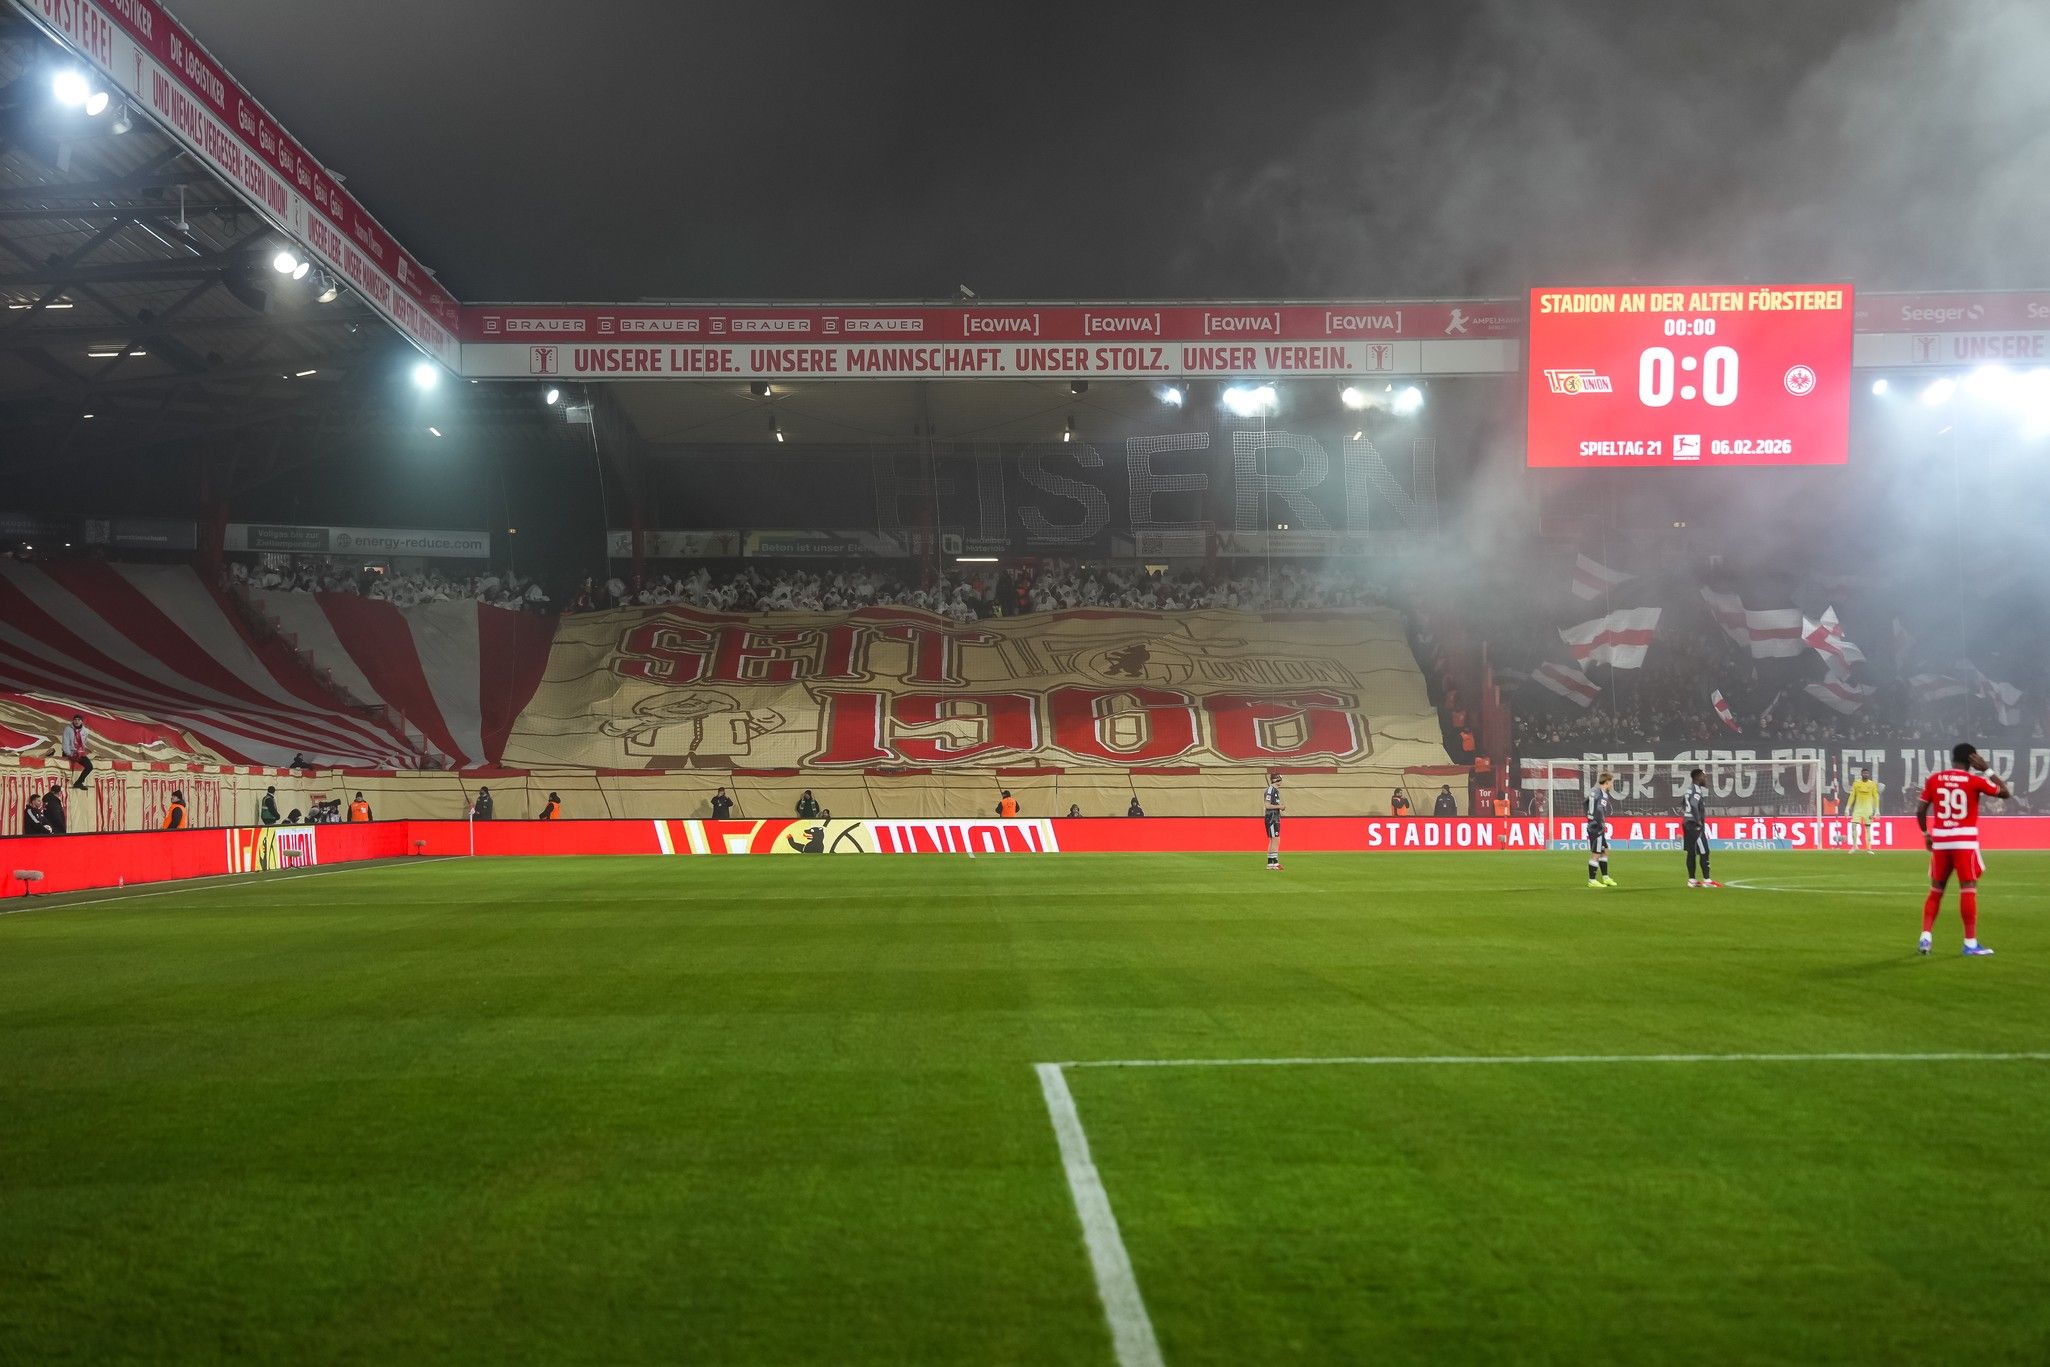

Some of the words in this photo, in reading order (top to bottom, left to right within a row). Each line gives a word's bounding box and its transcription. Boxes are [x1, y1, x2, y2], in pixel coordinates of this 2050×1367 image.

[34, 0, 112, 70] RSTEREI
[170, 33, 182, 67] DIE
[185, 47, 225, 110] LOGISTIKER
[153, 69, 169, 117] UND
[171, 86, 203, 146] NIEMALS
[244, 154, 266, 204] EISERN
[1540, 294, 1615, 314] STADION
[1620, 294, 1646, 312] AN
[1651, 293, 1684, 312] DER
[1689, 292, 1744, 311] ALTEN
[1748, 288, 1843, 311] FÖRSTEREI
[507, 320, 585, 330] BRAUER
[620, 320, 699, 331] BRAUER
[732, 320, 810, 331] BRAUER
[845, 319, 923, 331] BRAUER
[1902, 305, 1965, 323] Seeger
[1664, 318, 1716, 336] 00:00
[575, 348, 662, 372] UNSERE
[670, 348, 741, 372] LIEBE.
[751, 348, 837, 372] UNSERE
[846, 347, 1005, 372] MANNSCHAFT.
[1016, 347, 1090, 371] UNSER
[1096, 347, 1170, 371] STOLZ.
[1183, 347, 1257, 371] UNSER
[1266, 346, 1353, 371] VEREIN.
[1954, 336, 2045, 359] UNSERE
[1582, 378, 1610, 391] UNION
[1638, 345, 1739, 408] 0:0
[1579, 441, 1643, 457] SPIELTAG
[1646, 440, 1662, 456] 21
[1711, 439, 1792, 456] 06.02.2026
[873, 430, 1438, 541] EISERN
[354, 534, 483, 552] energy-reduce.com
[761, 543, 793, 552] Beton
[797, 543, 811, 552] ist
[814, 544, 844, 552] unser
[614, 624, 1000, 686] SEIT
[1198, 655, 1362, 689] UNION
[802, 685, 1372, 770] 1966
[1583, 750, 1655, 800] DER
[1671, 749, 1757, 799] SIEG
[1771, 748, 1886, 798] FOLGT
[142, 778, 221, 830] GESLTEN
[1479, 789, 1491, 797] Tor
[1936, 787, 1968, 820] 39
[873, 824, 1045, 854] UNION
[1367, 822, 1493, 847] STADION
[1508, 822, 1544, 846] AN
[1630, 822, 1718, 841] ALTN
[1733, 818, 1893, 847] FÖRSTEREI
[1736, 839, 1777, 850] raisin
